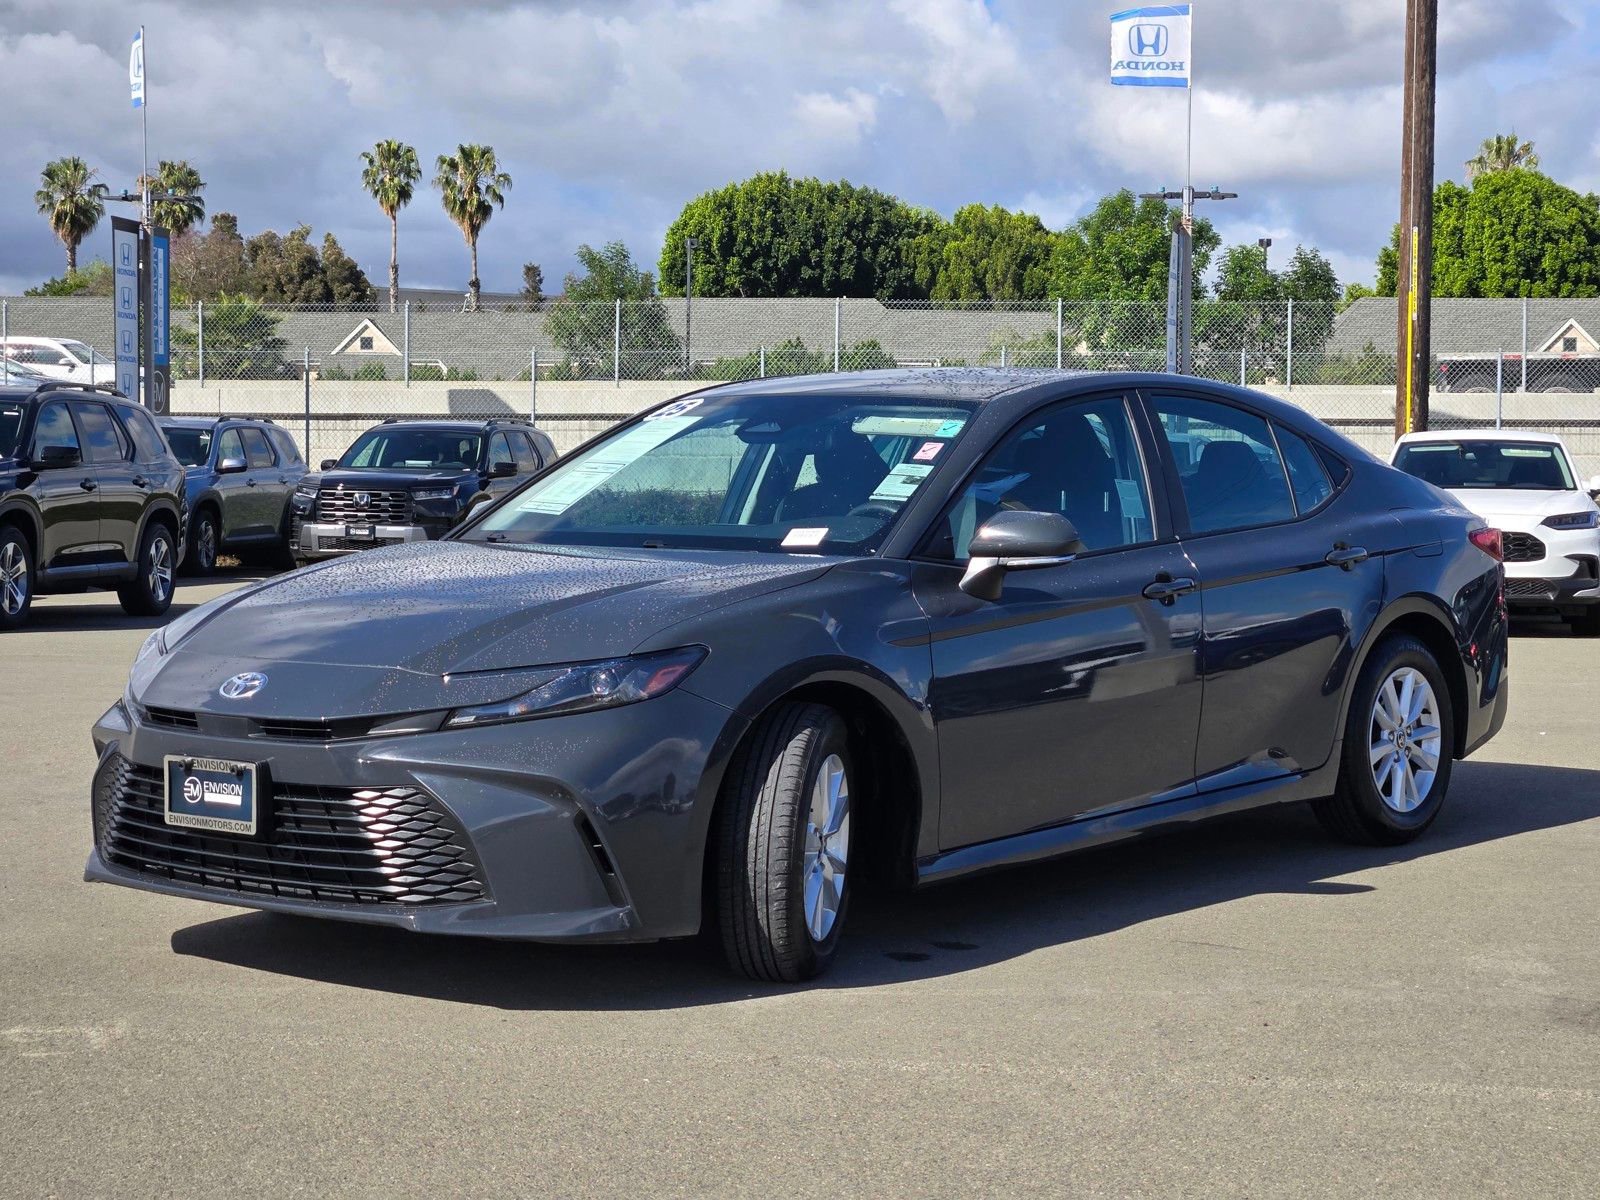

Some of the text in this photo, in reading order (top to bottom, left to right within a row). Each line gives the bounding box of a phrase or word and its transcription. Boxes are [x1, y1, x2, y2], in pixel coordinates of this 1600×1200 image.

[117, 267, 136, 278] HONDA
[117, 311, 136, 320] HONDA
[117, 354, 136, 363] HONDA
[192, 760, 231, 771] ENVISION
[203, 781, 243, 796] ENVISION
[169, 814, 252, 832] ENVISIONMOTORS.COM
